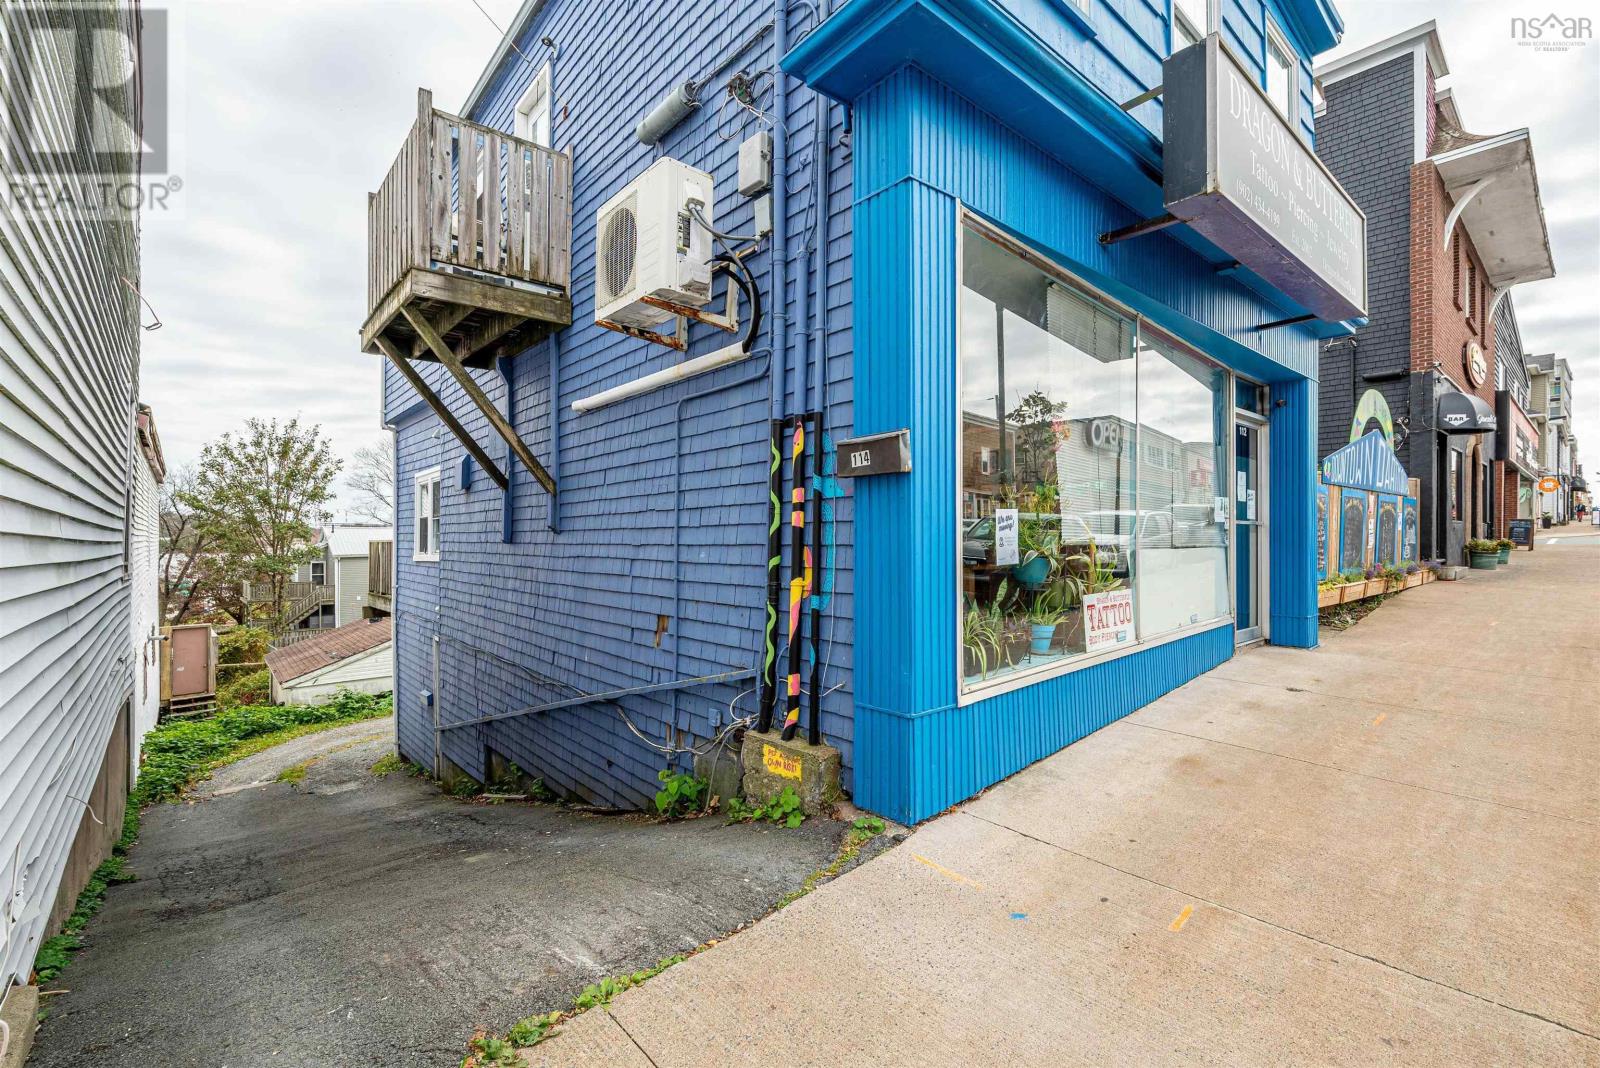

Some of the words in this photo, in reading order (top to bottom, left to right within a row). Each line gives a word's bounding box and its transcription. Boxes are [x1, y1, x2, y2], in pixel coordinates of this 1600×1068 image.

[1228, 70, 1291, 177] DRAGON
[1293, 152, 1304, 192] &
[1305, 160, 1358, 249] BUTTERFLY
[1236, 178, 1253, 207] (902)
[1250, 149, 1279, 197] Tattoo
[1288, 190, 1319, 243] Piercing
[1239, 426, 1248, 437] 112
[852, 451, 870, 467] 114
[1331, 436, 1375, 486] DOWNTOWN
[1087, 602, 1132, 632] TATTOO
